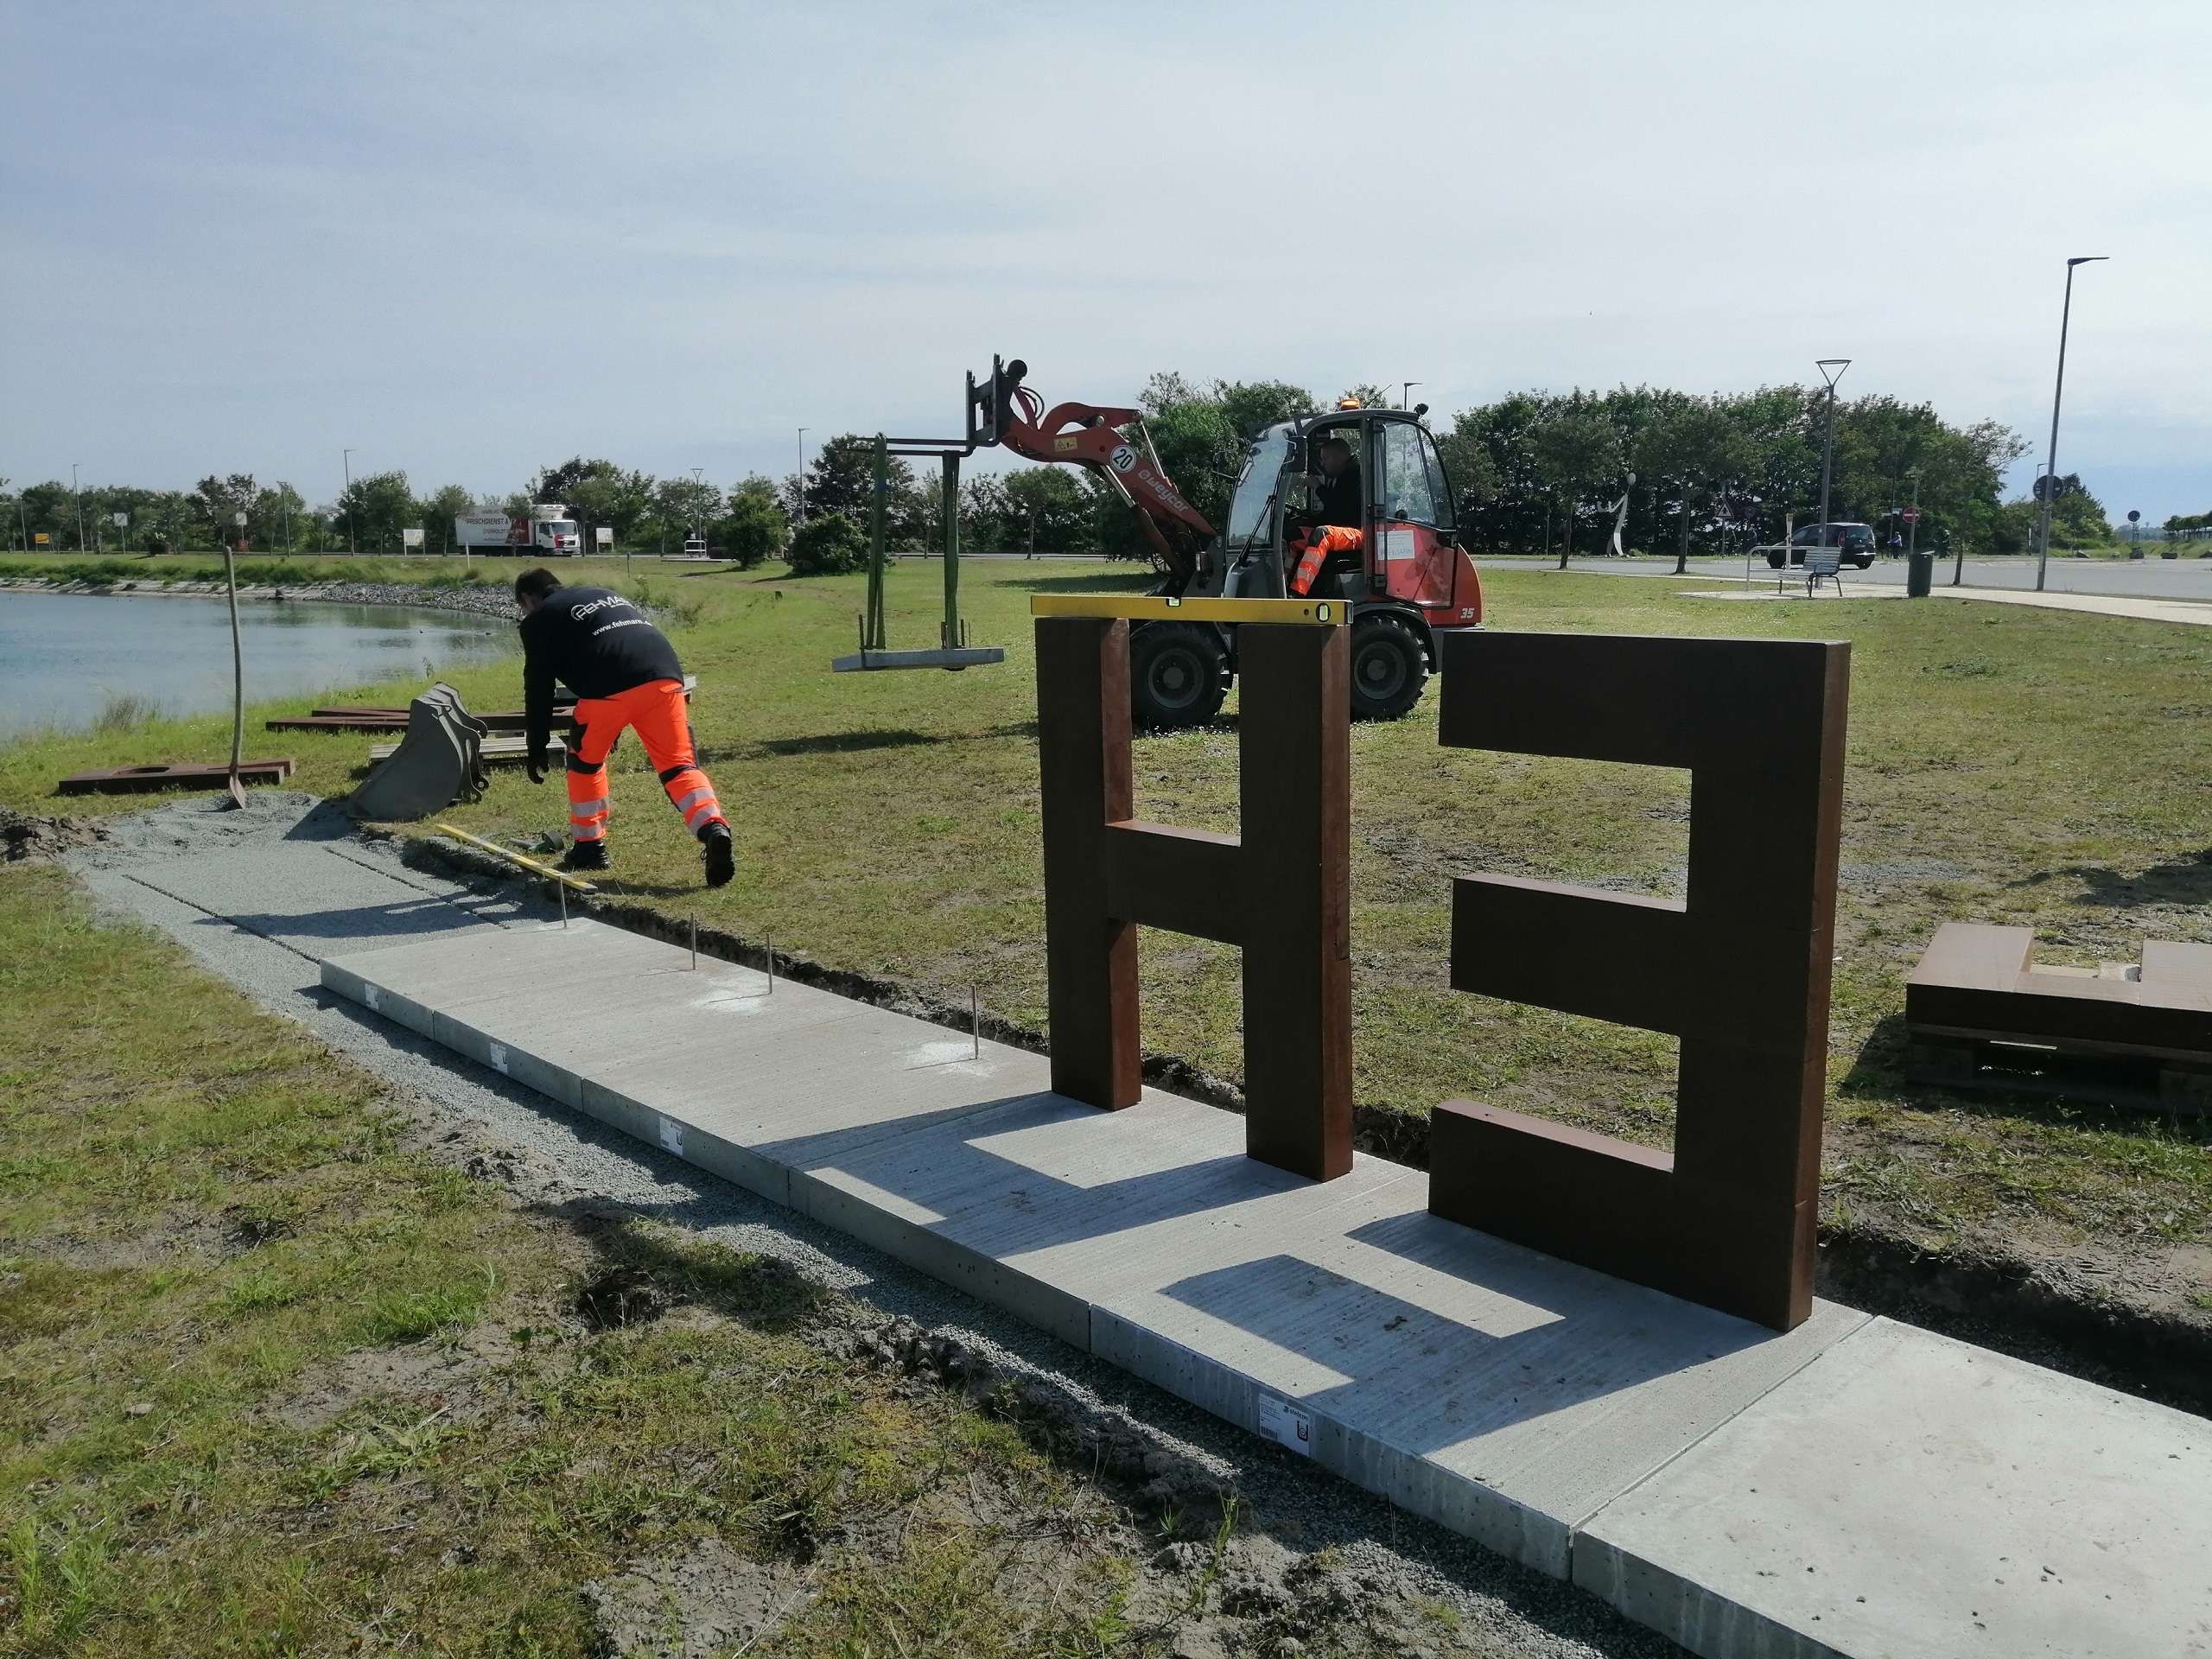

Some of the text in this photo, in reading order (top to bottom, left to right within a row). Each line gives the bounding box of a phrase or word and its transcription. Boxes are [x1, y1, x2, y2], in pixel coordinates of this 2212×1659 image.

[1113, 448, 1133, 469] 20
[575, 595, 629, 620] FEHMA
[1460, 607, 1475, 620] 35
[593, 619, 652, 636] www.fehmarn.
